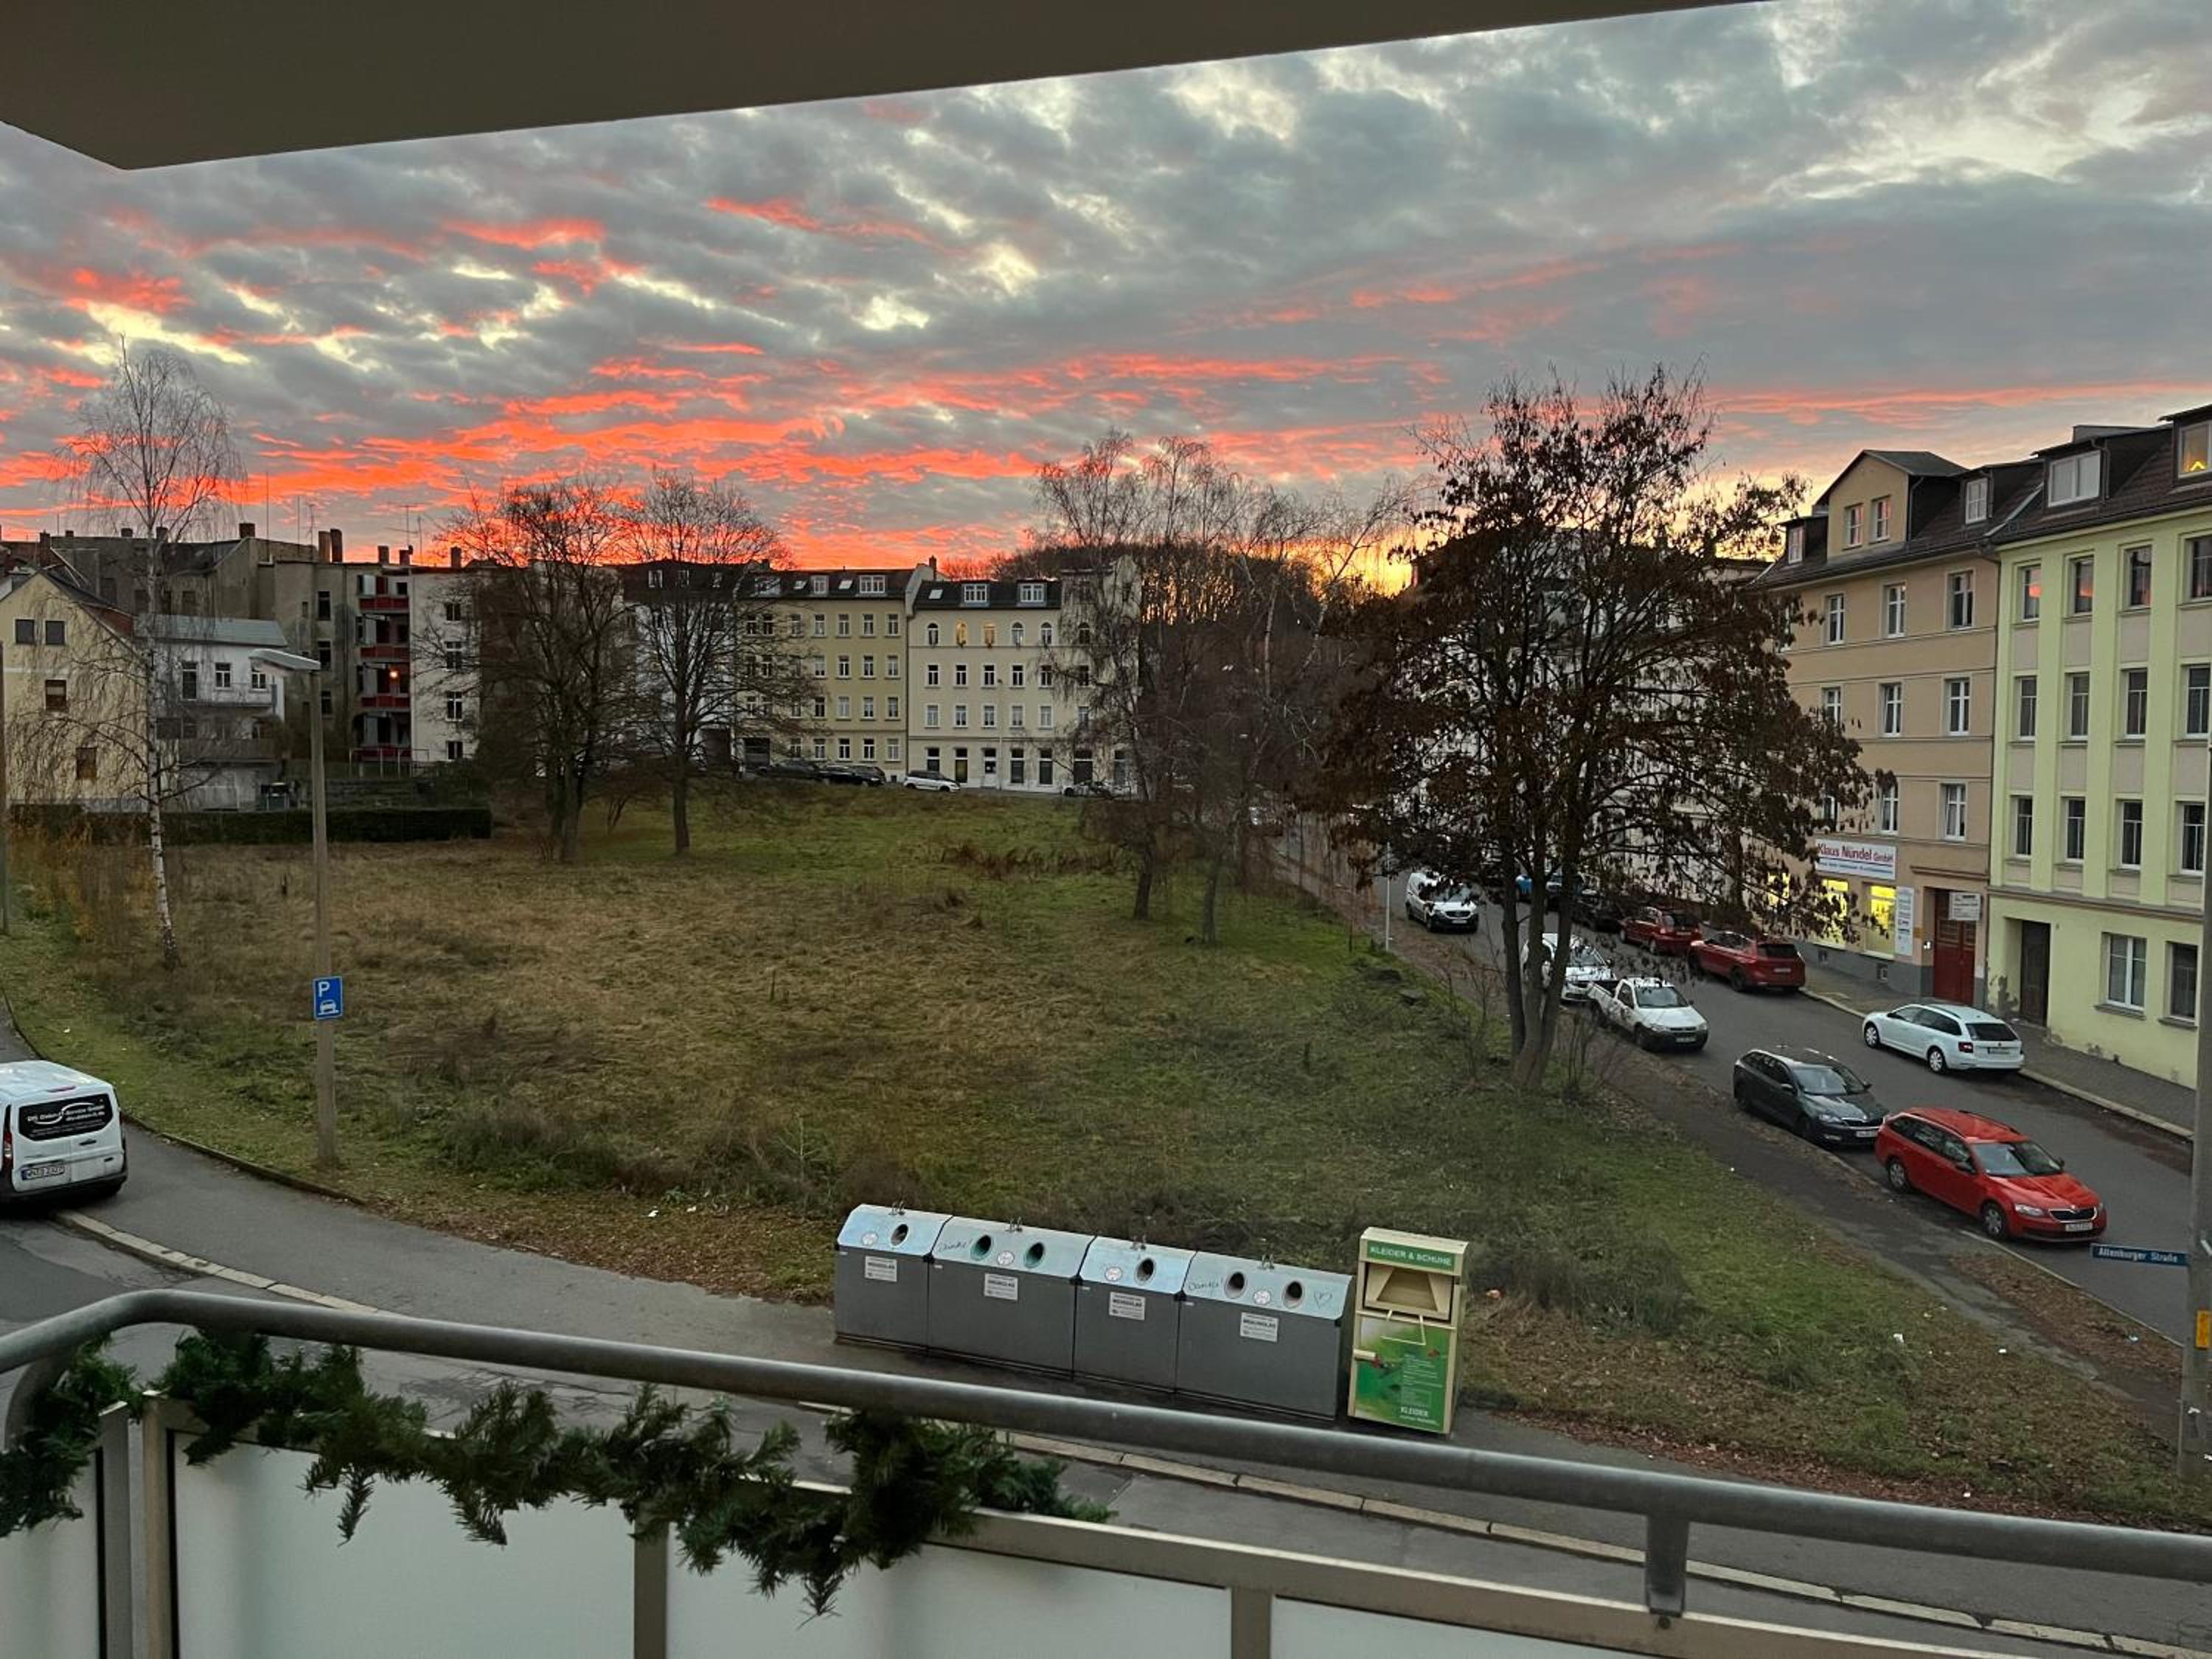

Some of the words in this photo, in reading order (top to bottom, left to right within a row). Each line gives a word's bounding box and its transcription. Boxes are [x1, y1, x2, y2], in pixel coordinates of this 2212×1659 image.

[1818, 844, 1840, 856] Klaus
[318, 981, 330, 997] P
[1369, 1246, 1406, 1259] KLEIDER
[1407, 1252, 1415, 1260] &
[1415, 1253, 1452, 1266] SCHUHE
[2098, 1247, 2147, 1262] Altenburger
[2151, 1251, 2178, 1263] Straße
